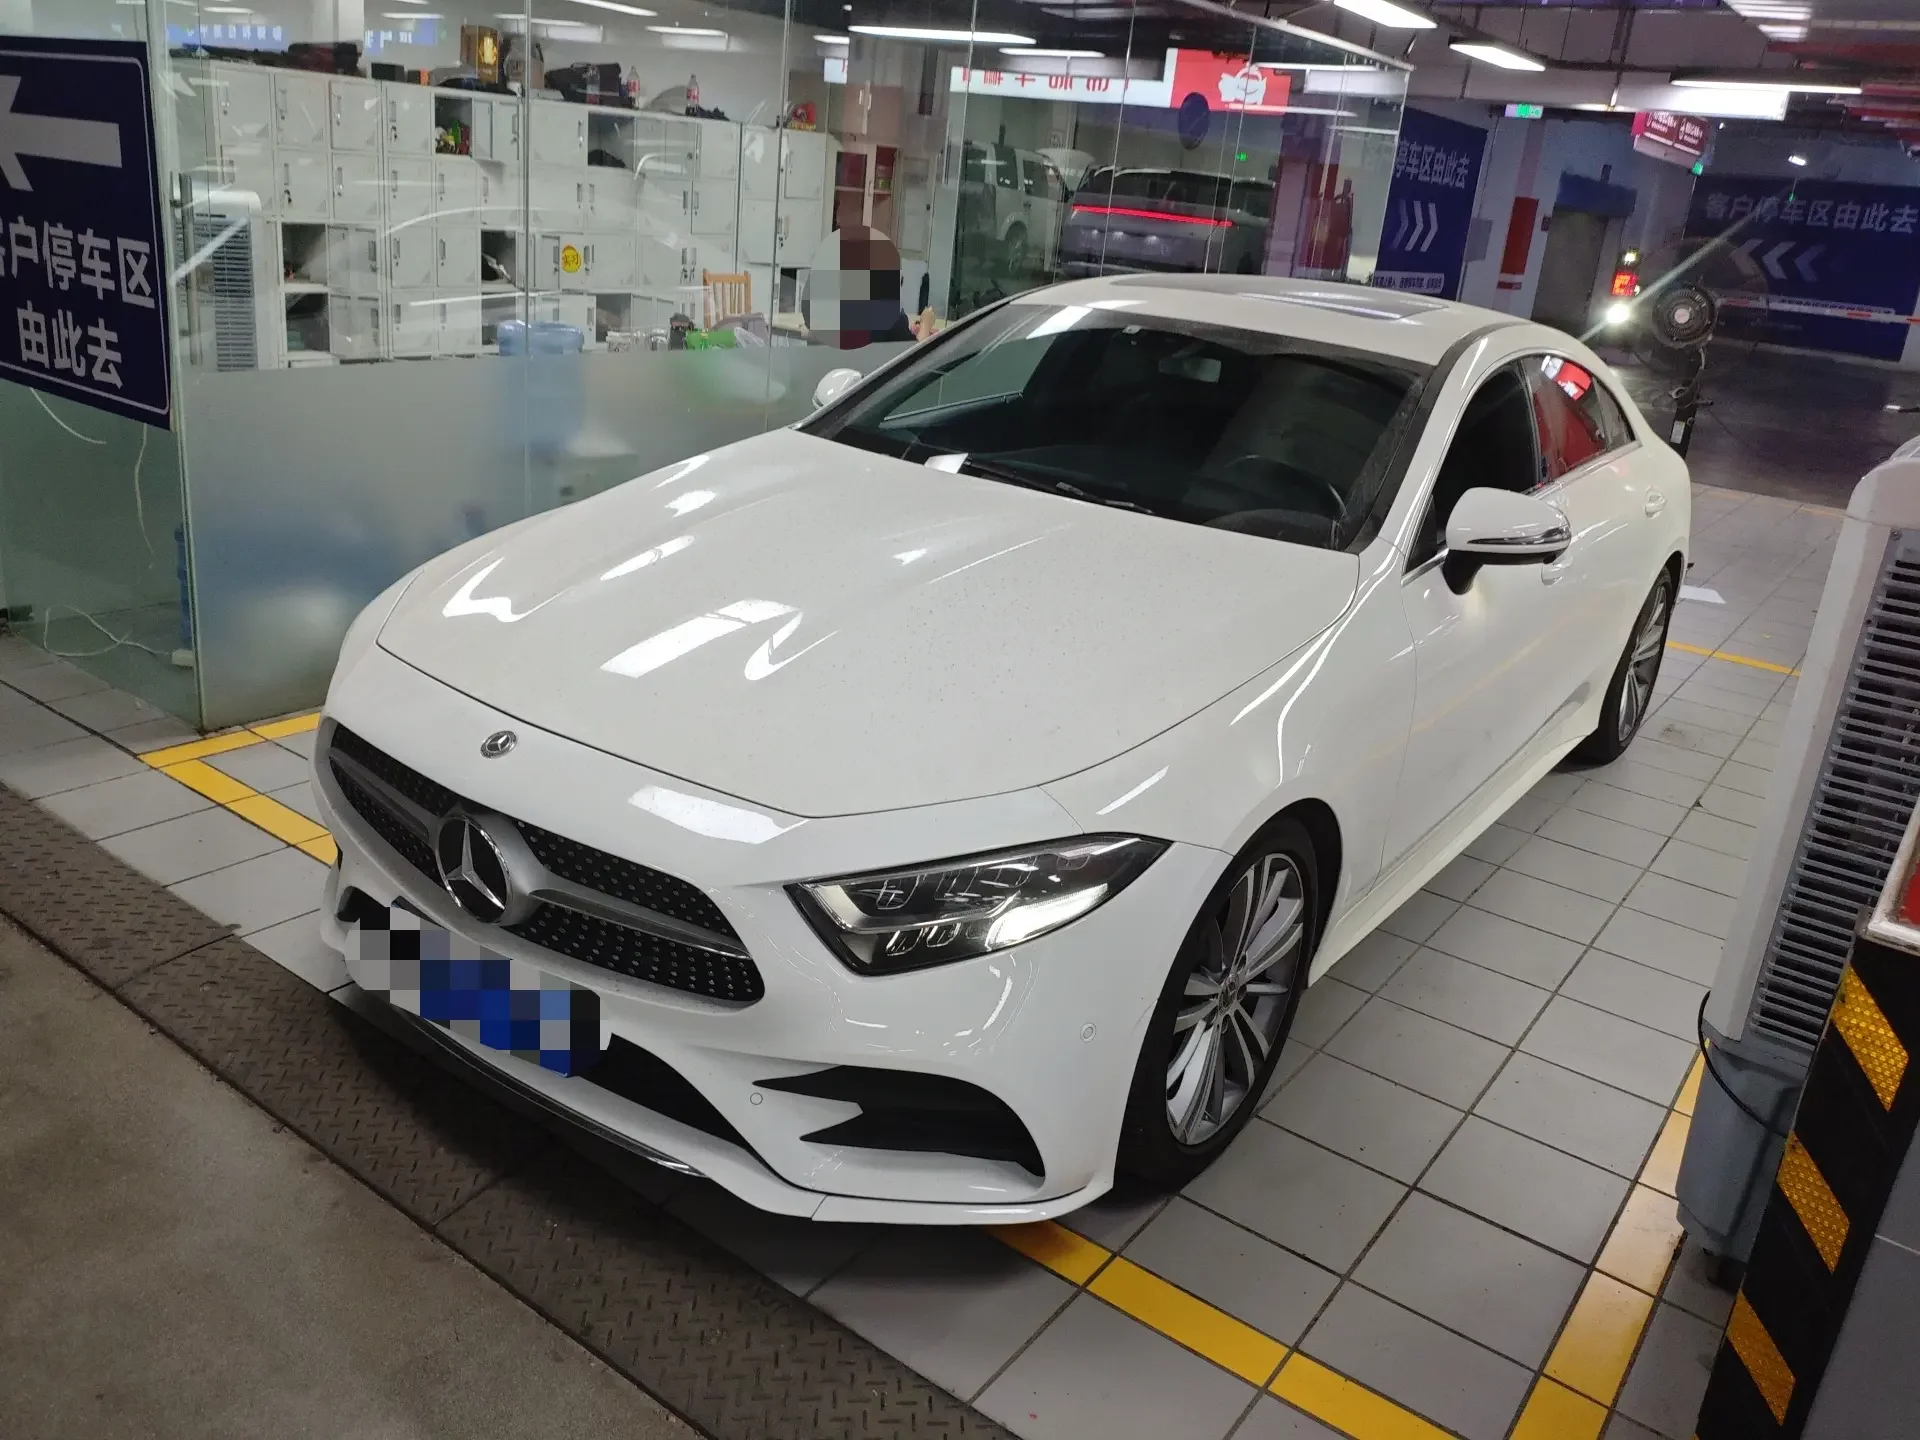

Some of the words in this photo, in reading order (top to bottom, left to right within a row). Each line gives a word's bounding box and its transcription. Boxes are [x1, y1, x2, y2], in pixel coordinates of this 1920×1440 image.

[1706, 192, 1918, 234] 客户停车区由此去
[0, 215, 155, 309] 户停车区
[16, 300, 123, 390] 由此去
